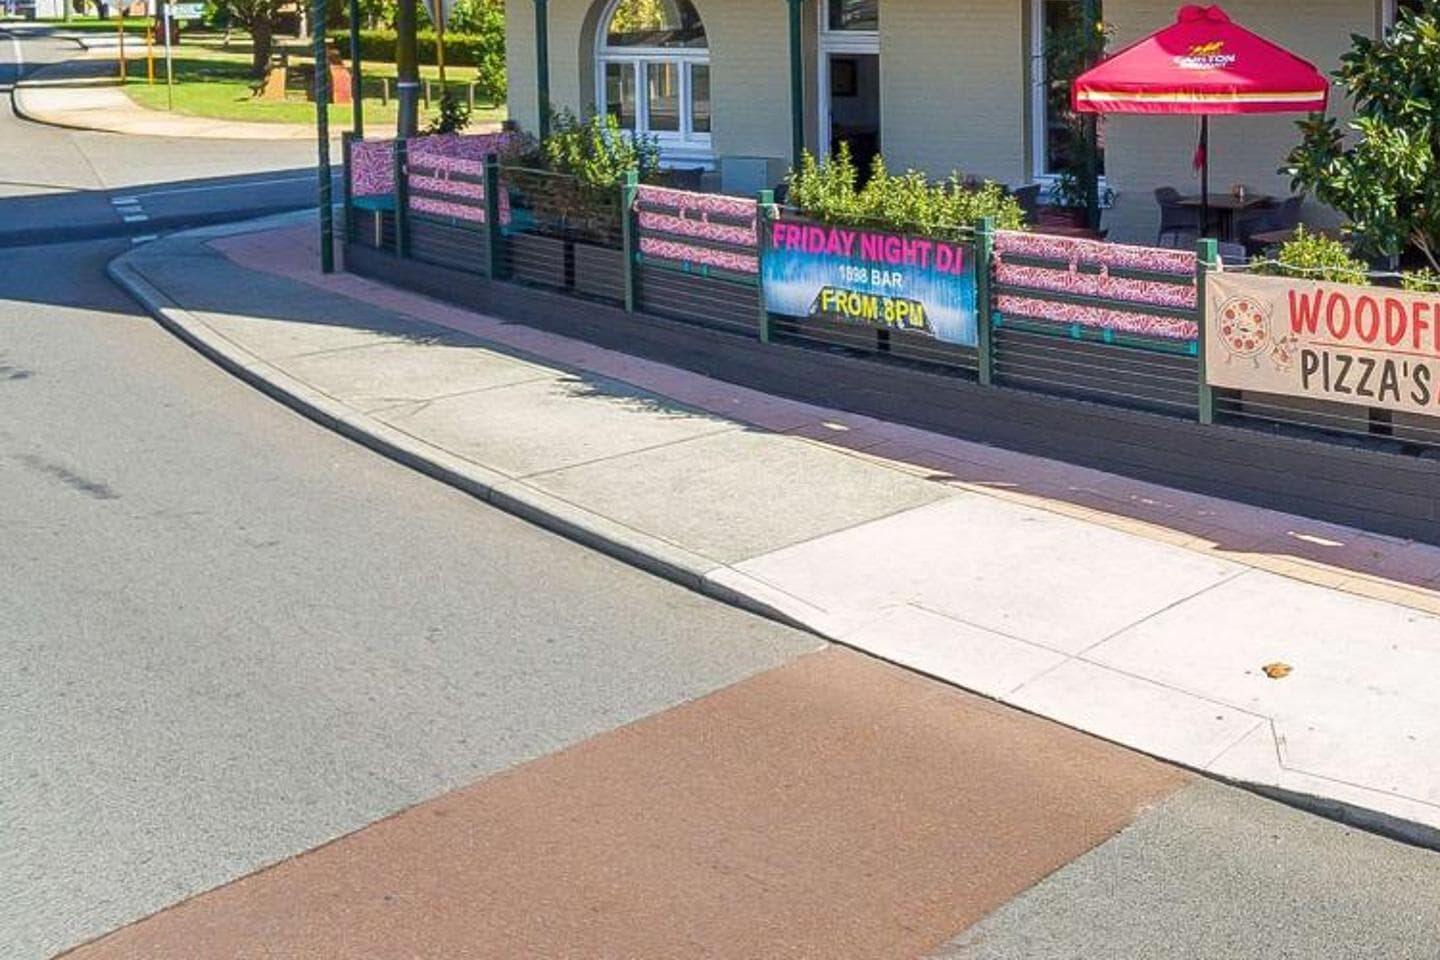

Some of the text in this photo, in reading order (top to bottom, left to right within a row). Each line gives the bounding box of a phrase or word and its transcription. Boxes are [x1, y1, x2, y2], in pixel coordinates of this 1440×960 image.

[772, 222, 964, 275] FRIDAY NIGHT DJ
[871, 269, 902, 287] BAR
[820, 289, 924, 327] FROM 8PM
[1301, 349, 1431, 406] PIZZA'S
